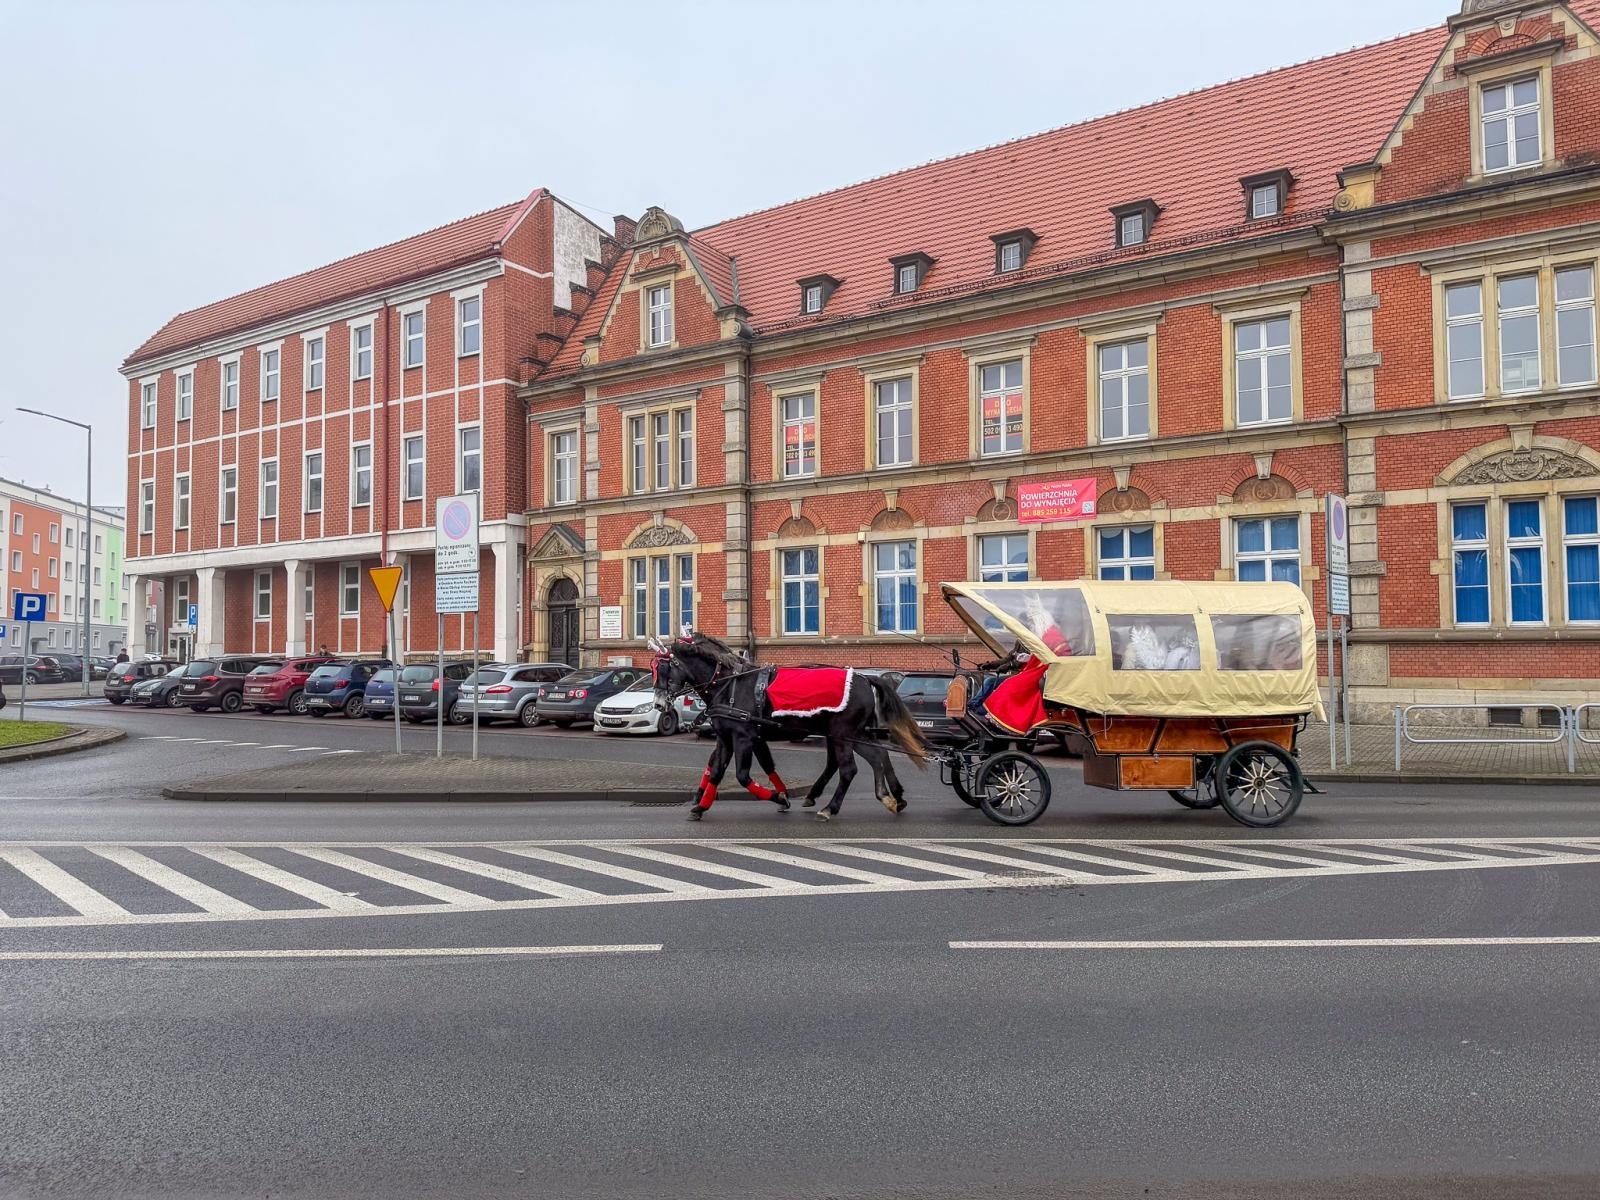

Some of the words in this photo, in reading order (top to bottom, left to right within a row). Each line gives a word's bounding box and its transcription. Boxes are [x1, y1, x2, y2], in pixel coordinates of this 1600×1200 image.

[1020, 489, 1078, 501] POWIERZCHNIA
[1021, 501, 1032, 509] DO
[1034, 498, 1077, 507] WYNAJĘCIA
[1059, 507, 1071, 515] 115
[22, 596, 40, 617] P
